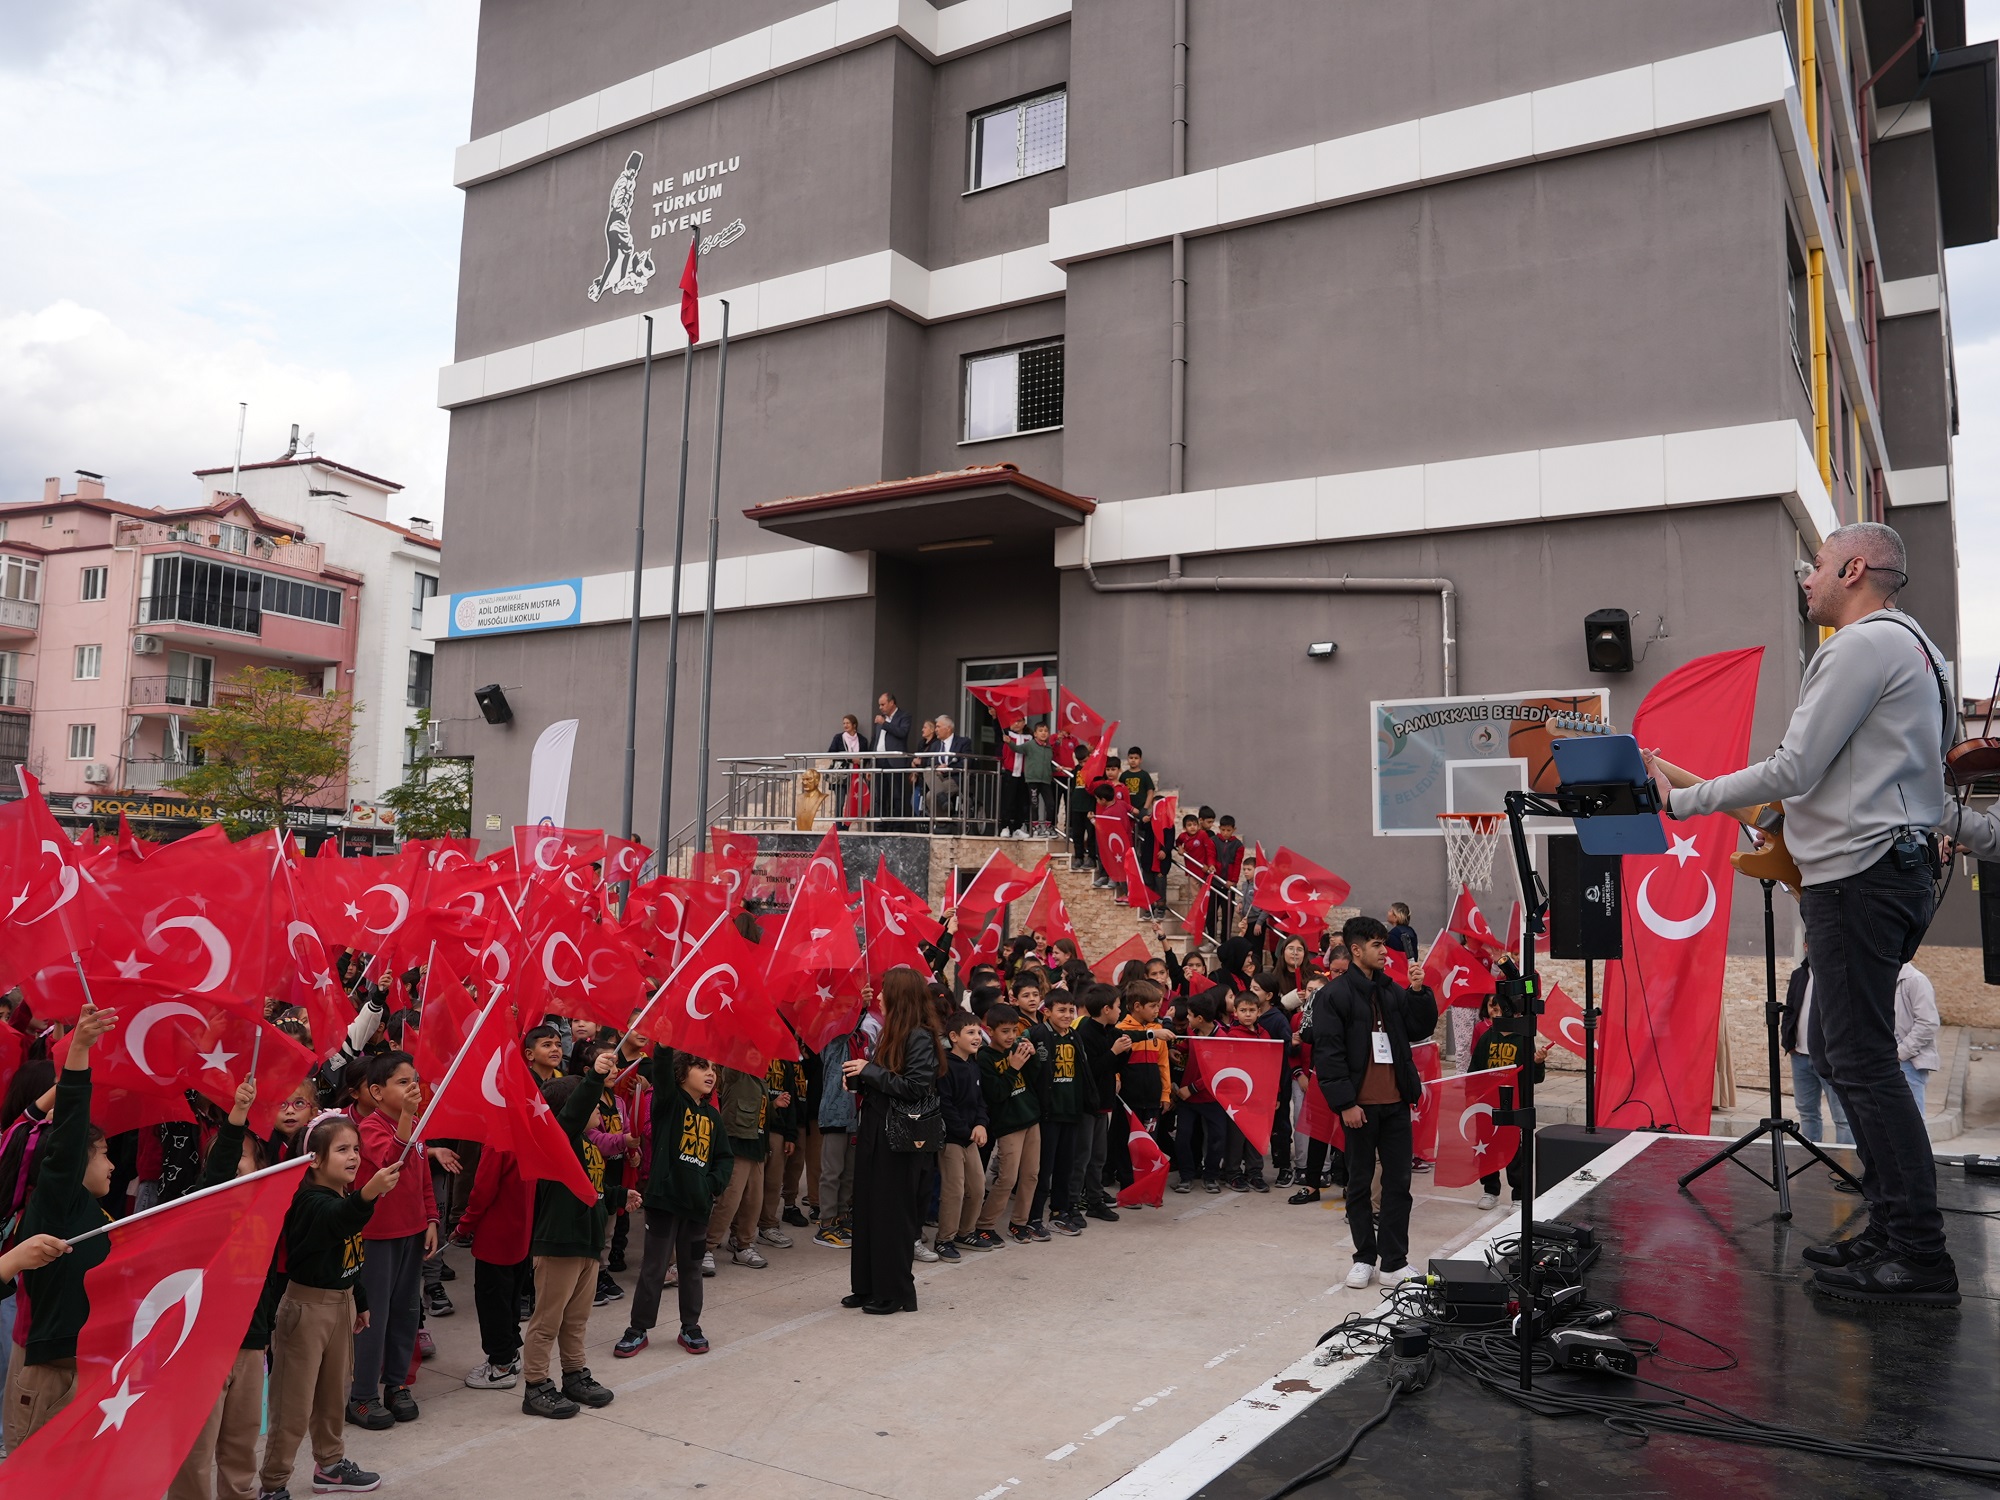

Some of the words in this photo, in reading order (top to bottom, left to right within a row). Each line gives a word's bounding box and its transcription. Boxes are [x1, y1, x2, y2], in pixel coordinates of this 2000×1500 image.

[652, 177, 674, 197] NE
[682, 156, 740, 187] MUTLU
[652, 183, 723, 216] TÜRKÜM
[651, 208, 712, 239] DİYENE
[478, 616, 508, 626] MUSOĞLU
[509, 613, 541, 623] İLKOKULU
[479, 605, 492, 615] ADİL
[494, 602, 529, 614] DEMİREREN
[530, 598, 560, 609] MUSTAFA
[1393, 705, 1489, 738] PAMUKKALE
[1492, 704, 1580, 722] BELEDİY
[93, 799, 213, 818] KOCAPINAR
